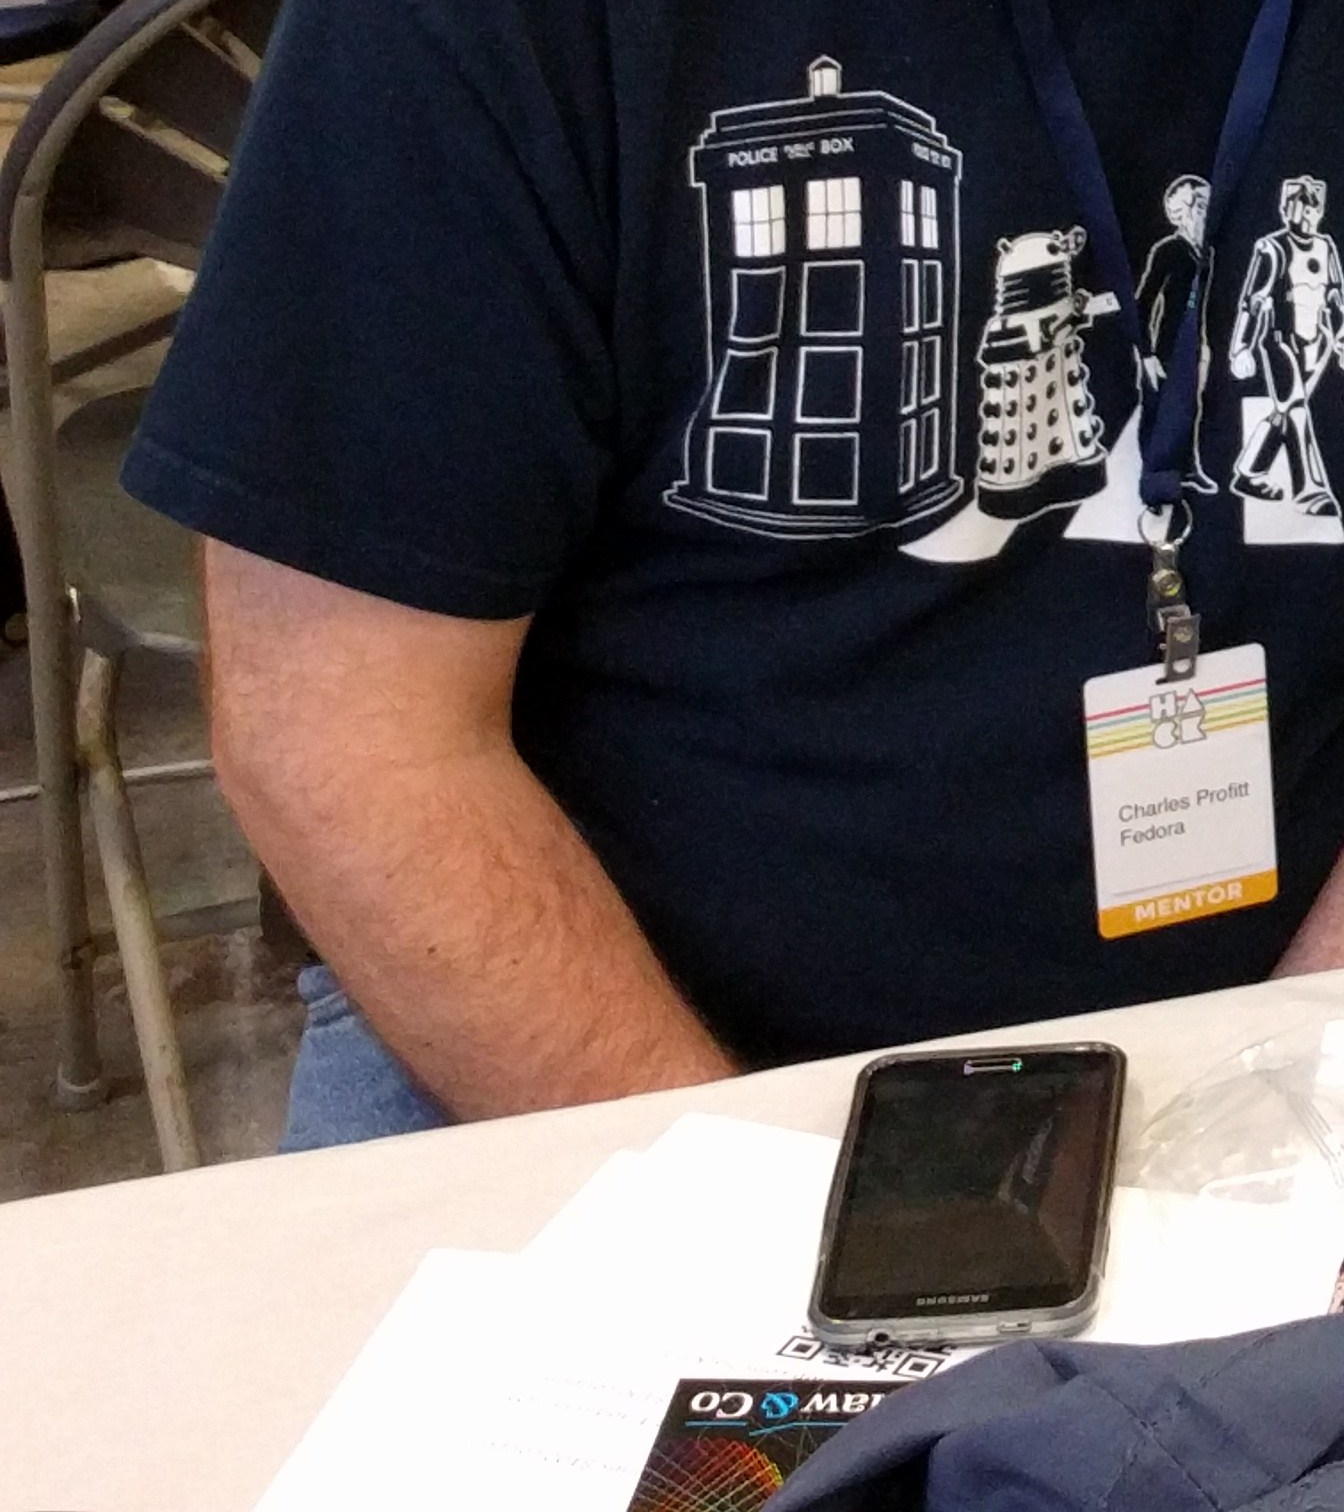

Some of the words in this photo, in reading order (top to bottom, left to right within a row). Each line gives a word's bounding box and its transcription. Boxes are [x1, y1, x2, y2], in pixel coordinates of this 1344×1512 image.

[728, 146, 779, 169] POLICE
[819, 137, 855, 156] BOX
[1118, 794, 1190, 824] Charles
[1196, 781, 1251, 806] Profitt
[1119, 819, 1187, 847] Fedora
[1133, 879, 1244, 924] MENTOR
[690, 1391, 754, 1419] Co
[761, 1391, 799, 1419] &
[799, 1392, 884, 1414] aw
